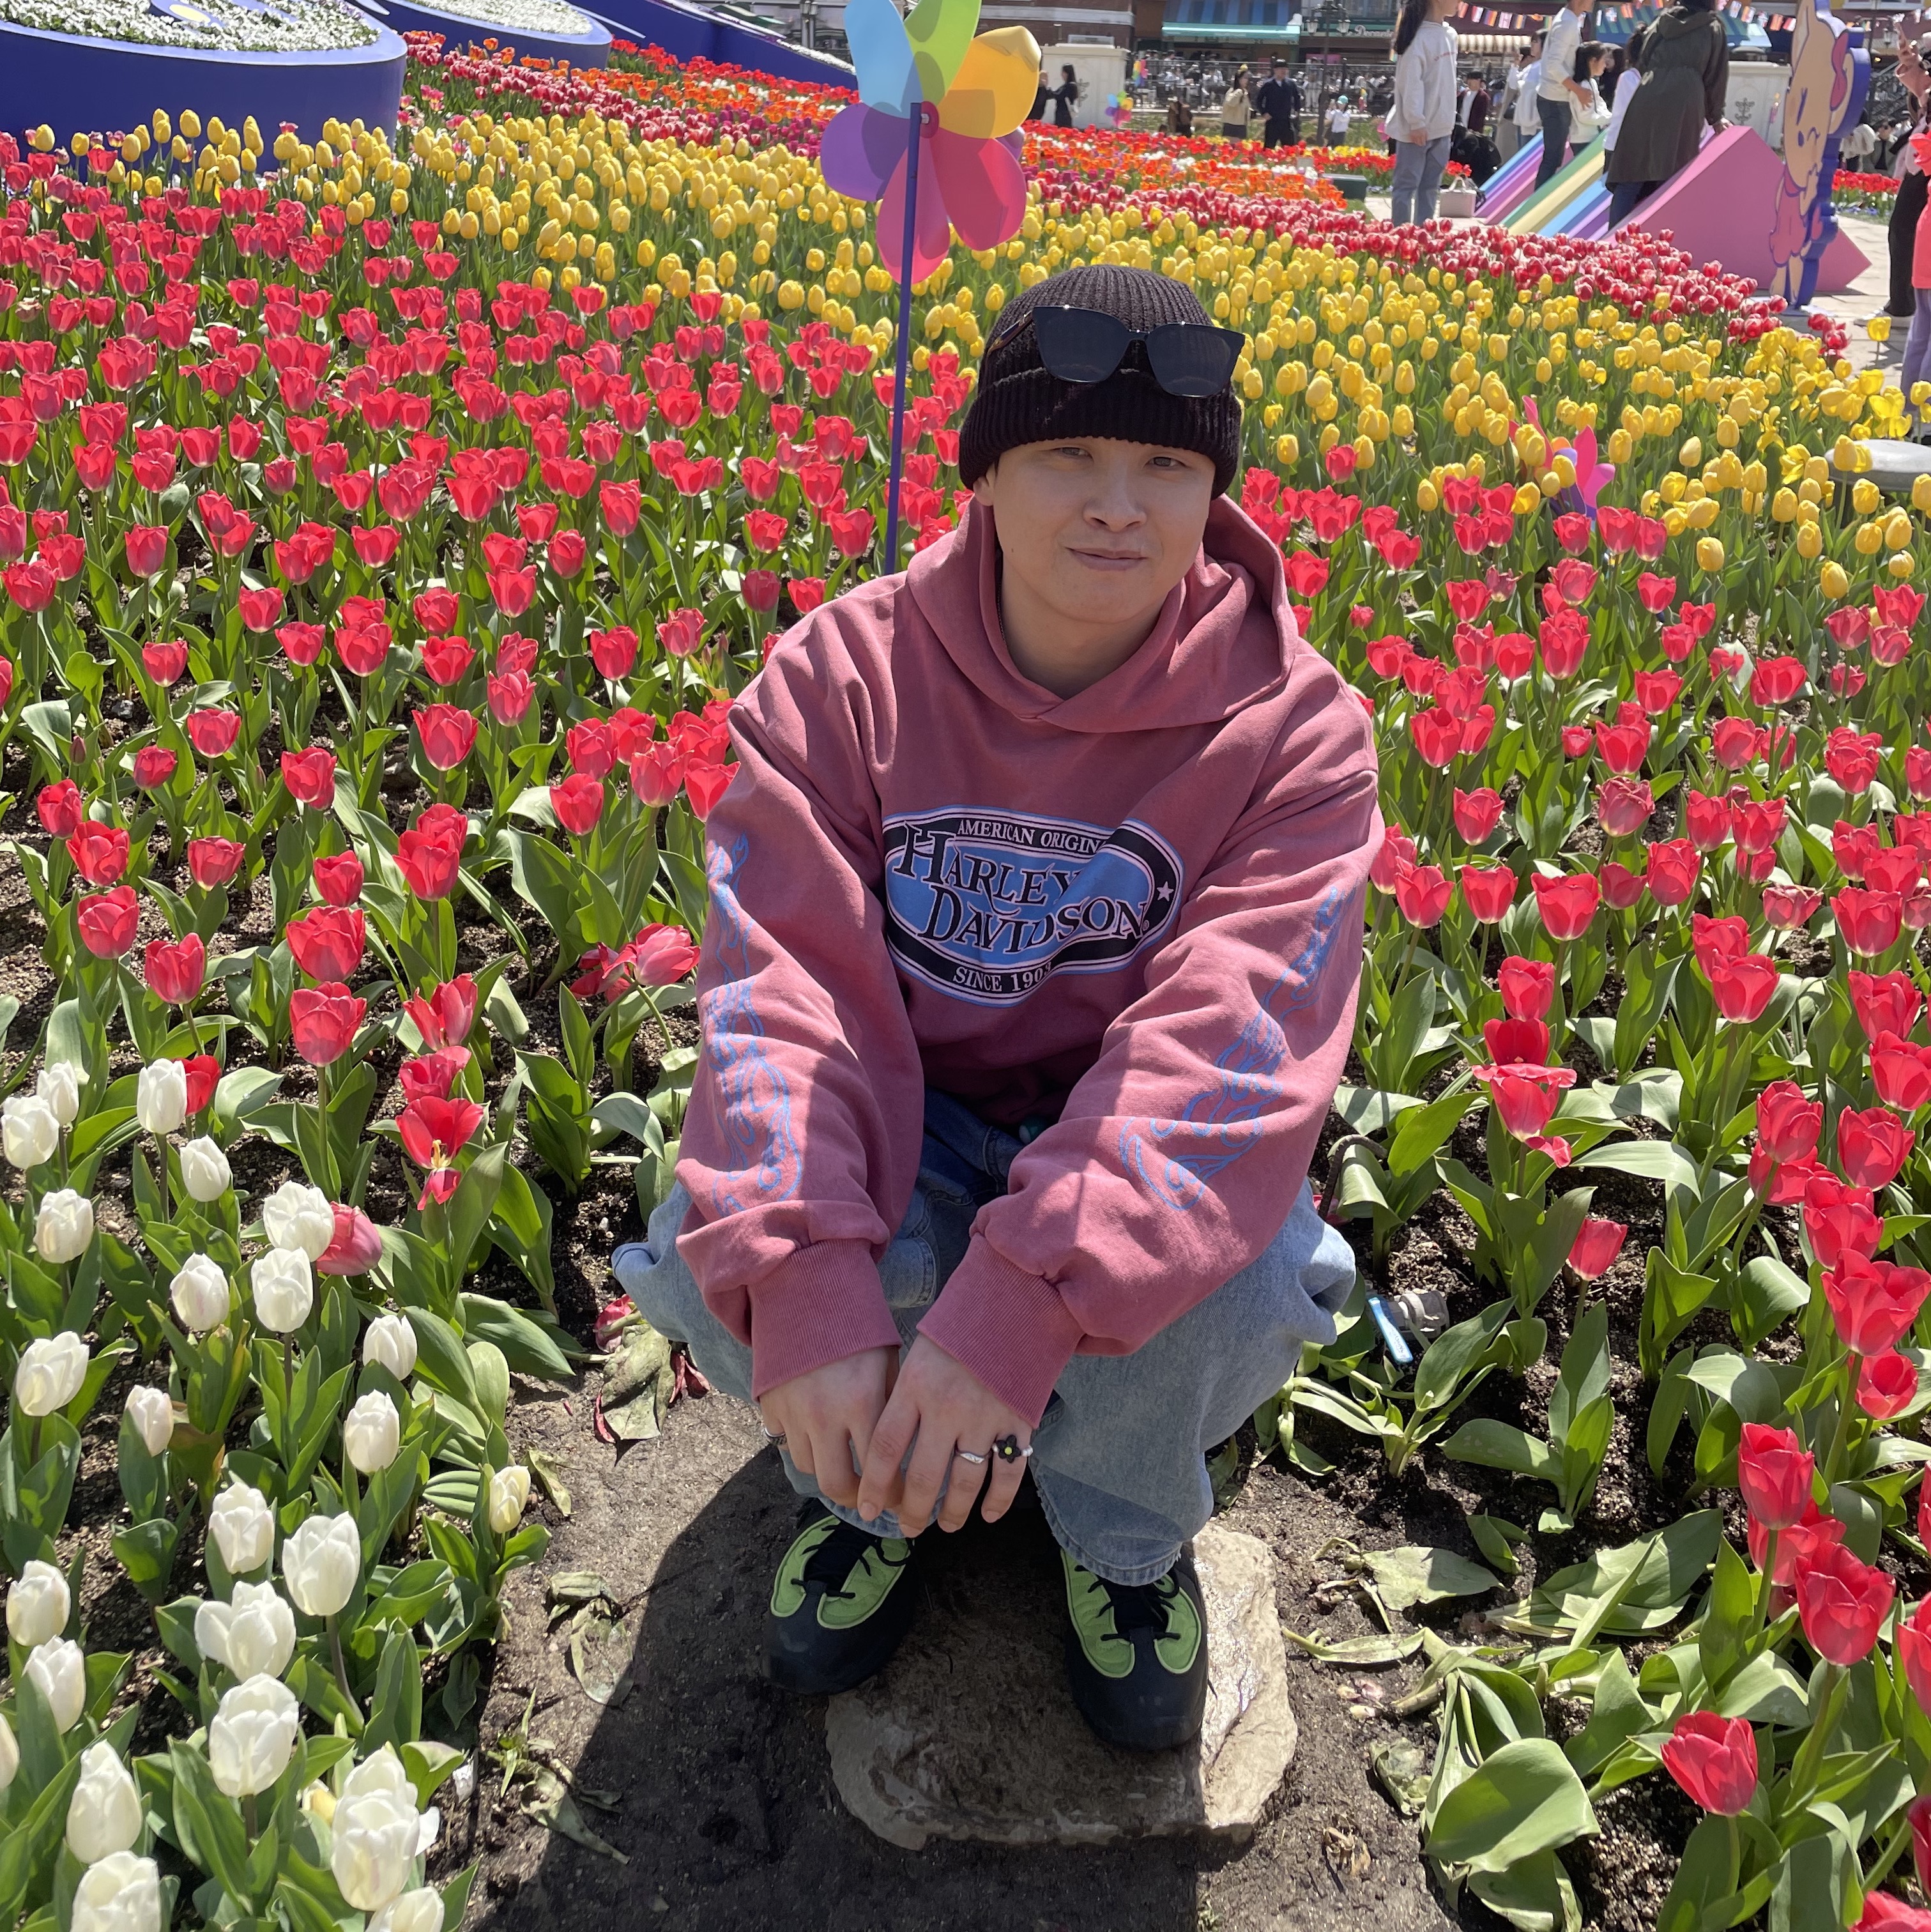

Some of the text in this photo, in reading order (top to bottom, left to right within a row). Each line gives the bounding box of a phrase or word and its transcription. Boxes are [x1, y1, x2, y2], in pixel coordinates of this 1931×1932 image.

[958, 819, 1107, 854] AMERICAN ORIGIN
[892, 820, 1082, 916] HARLEY
[918, 884, 1147, 954] DAVIDSON
[952, 966, 1002, 992] SINCE
